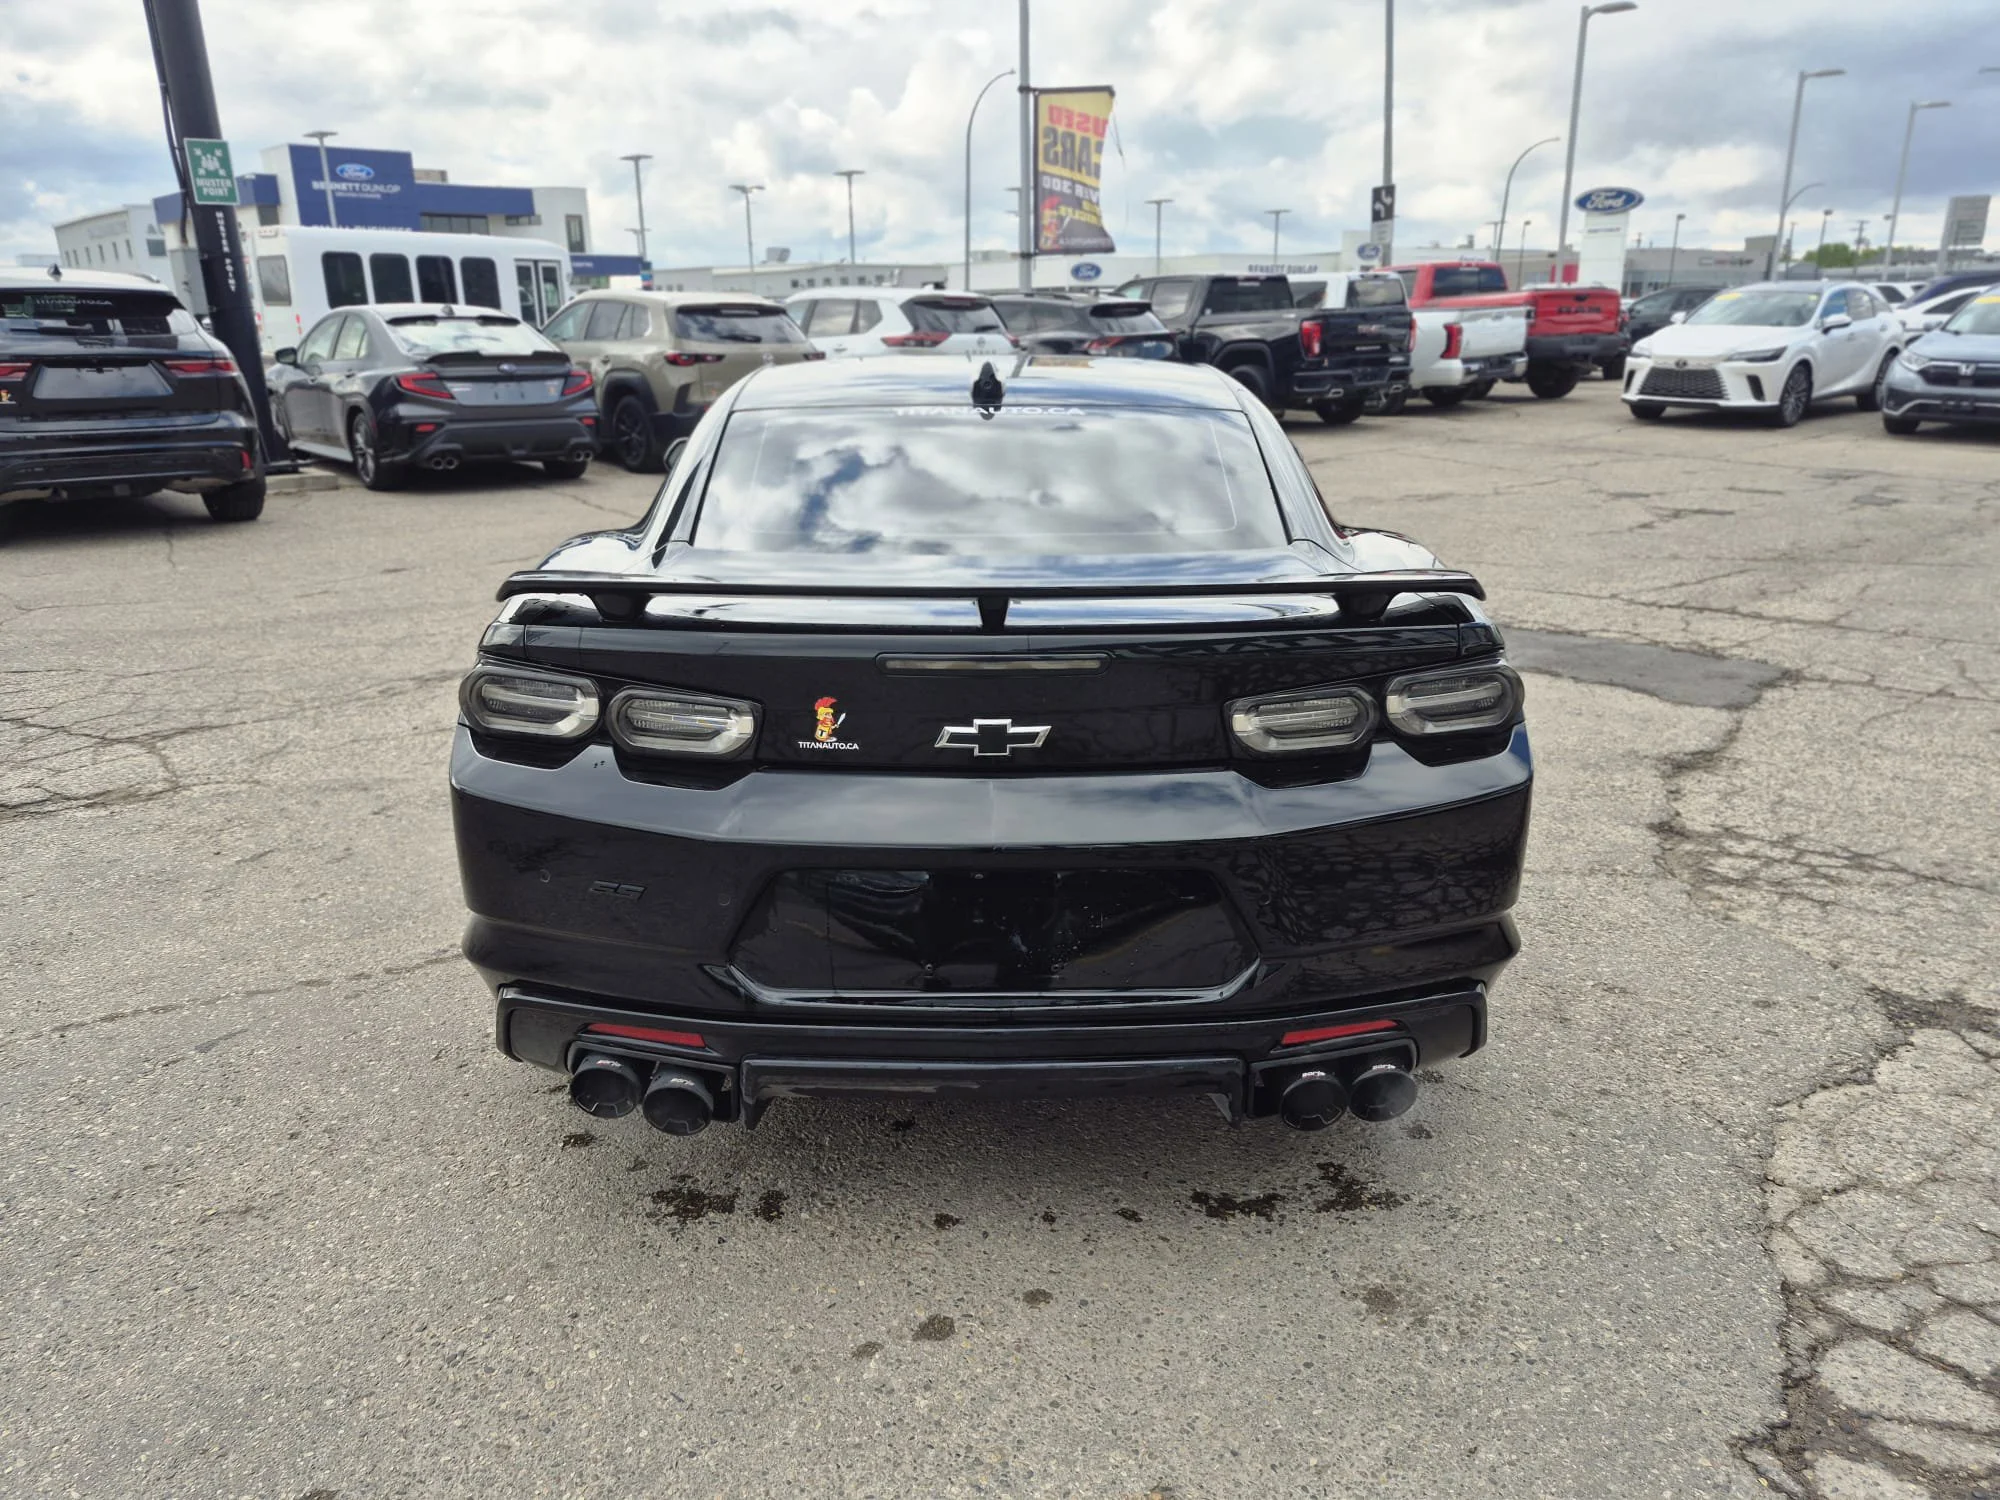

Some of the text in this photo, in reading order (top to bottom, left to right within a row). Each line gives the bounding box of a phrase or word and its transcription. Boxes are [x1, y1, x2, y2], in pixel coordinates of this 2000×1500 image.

[196, 178, 232, 188] MUSTER
[312, 181, 361, 192] BENETT
[202, 187, 228, 197] POINT
[1585, 191, 1628, 209] Ford
[215, 211, 236, 293] MUSTER POINT
[893, 405, 1086, 416] TITANAUTO.CA
[797, 741, 860, 750] TITANAUTO.CA
